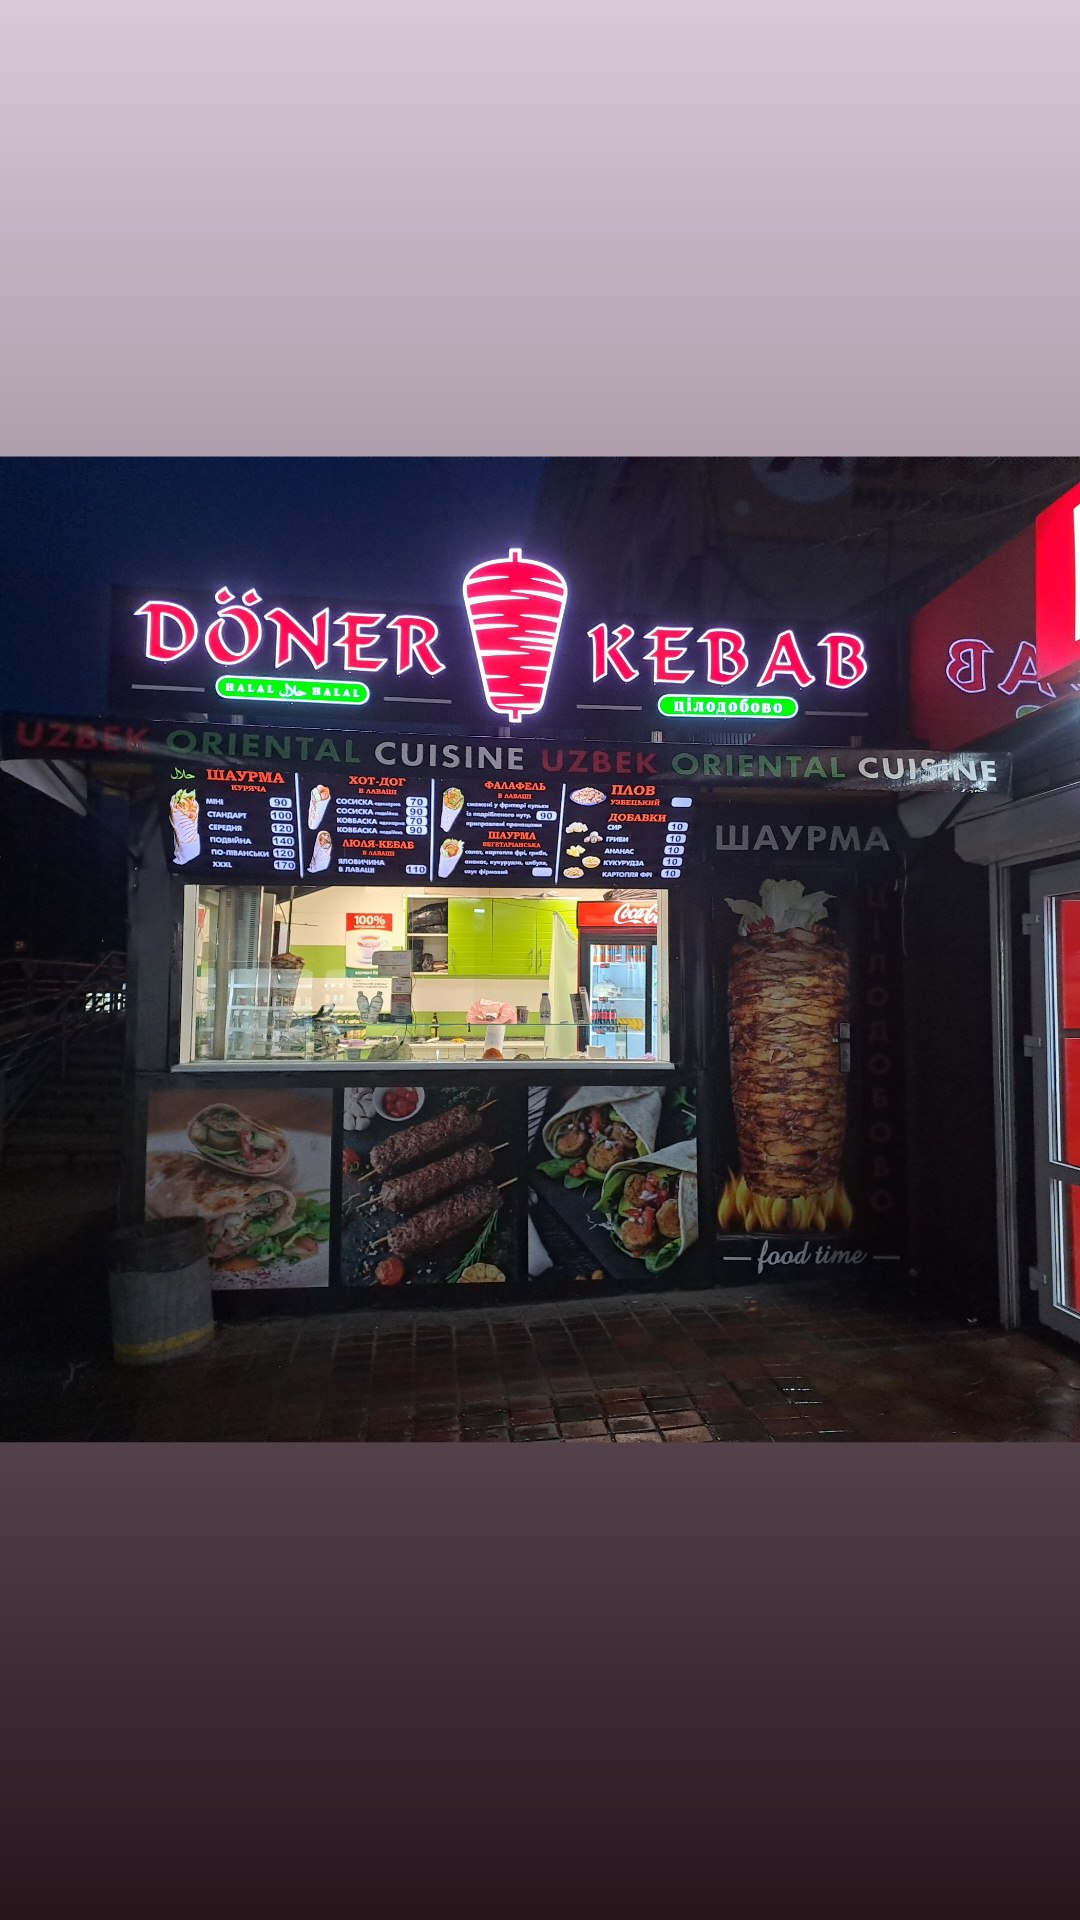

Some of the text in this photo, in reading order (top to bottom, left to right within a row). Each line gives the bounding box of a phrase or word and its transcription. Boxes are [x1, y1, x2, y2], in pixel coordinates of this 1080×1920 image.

[133, 586, 868, 689] DÖNER KEBAB
[225, 683, 274, 694] HALAL
[312, 687, 360, 698] HALAL
[673, 698, 783, 715] цілодобово
[16, 719, 998, 783] UZBEK ORIENTAL CUISINE UZBEK ORIENTAL CUISINE
[207, 769, 285, 784] ШАУРМА
[349, 776, 406, 787] ХОТ-ДОГ
[231, 785, 267, 793] КУРЯЧА
[484, 781, 547, 791] ФАЛАФЕЛЬ
[611, 784, 656, 796] ПЛОВ
[273, 799, 288, 807] 90
[336, 798, 373, 806] СОСИСКА
[410, 798, 424, 806] 70
[207, 811, 291, 820] СТАНДАРТ 100
[336, 808, 374, 816] СОСИСКА
[409, 808, 423, 816] 90
[608, 813, 667, 823] ДОБАВКИ
[208, 824, 242, 832] СЕРЕДНЯ
[210, 836, 293, 845] ПОДВІЙНА 140
[488, 831, 537, 840] ШАУРМА
[715, 824, 891, 852] ШАУРМА
[342, 839, 415, 849] ЛЮЛЯ-КЕБАБ
[211, 849, 270, 858] ПО-ЛІВАНСЬКИ
[354, 915, 386, 925] 100%
[757, 1240, 867, 1274] food time
